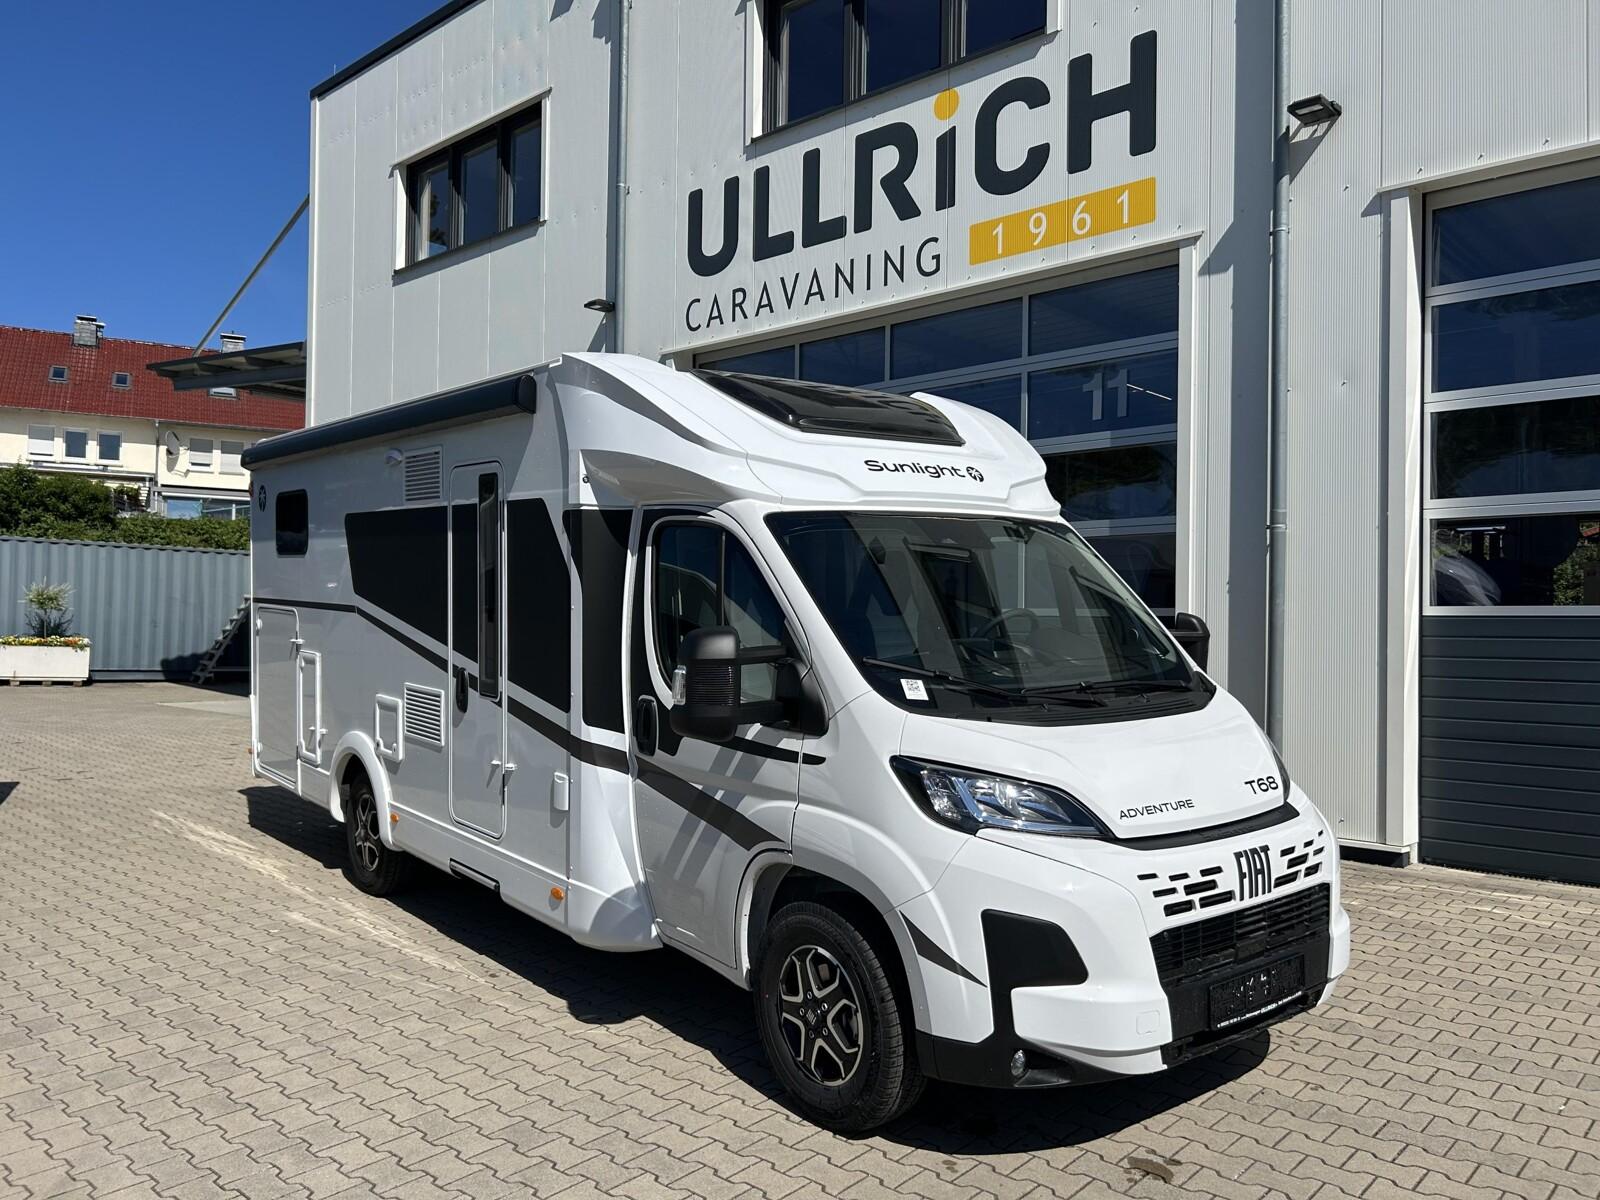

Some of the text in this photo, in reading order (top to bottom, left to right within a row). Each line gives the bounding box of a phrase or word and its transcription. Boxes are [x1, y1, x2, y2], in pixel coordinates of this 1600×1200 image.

[992, 189, 1132, 256] 1961
[685, 236, 941, 332] CARAVANING
[1082, 368, 1127, 420] 11
[864, 460, 966, 478] Sunlight
[1119, 798, 1195, 820] ADVENTURE
[1245, 775, 1279, 795] T68
[1233, 844, 1273, 901] FIAT
